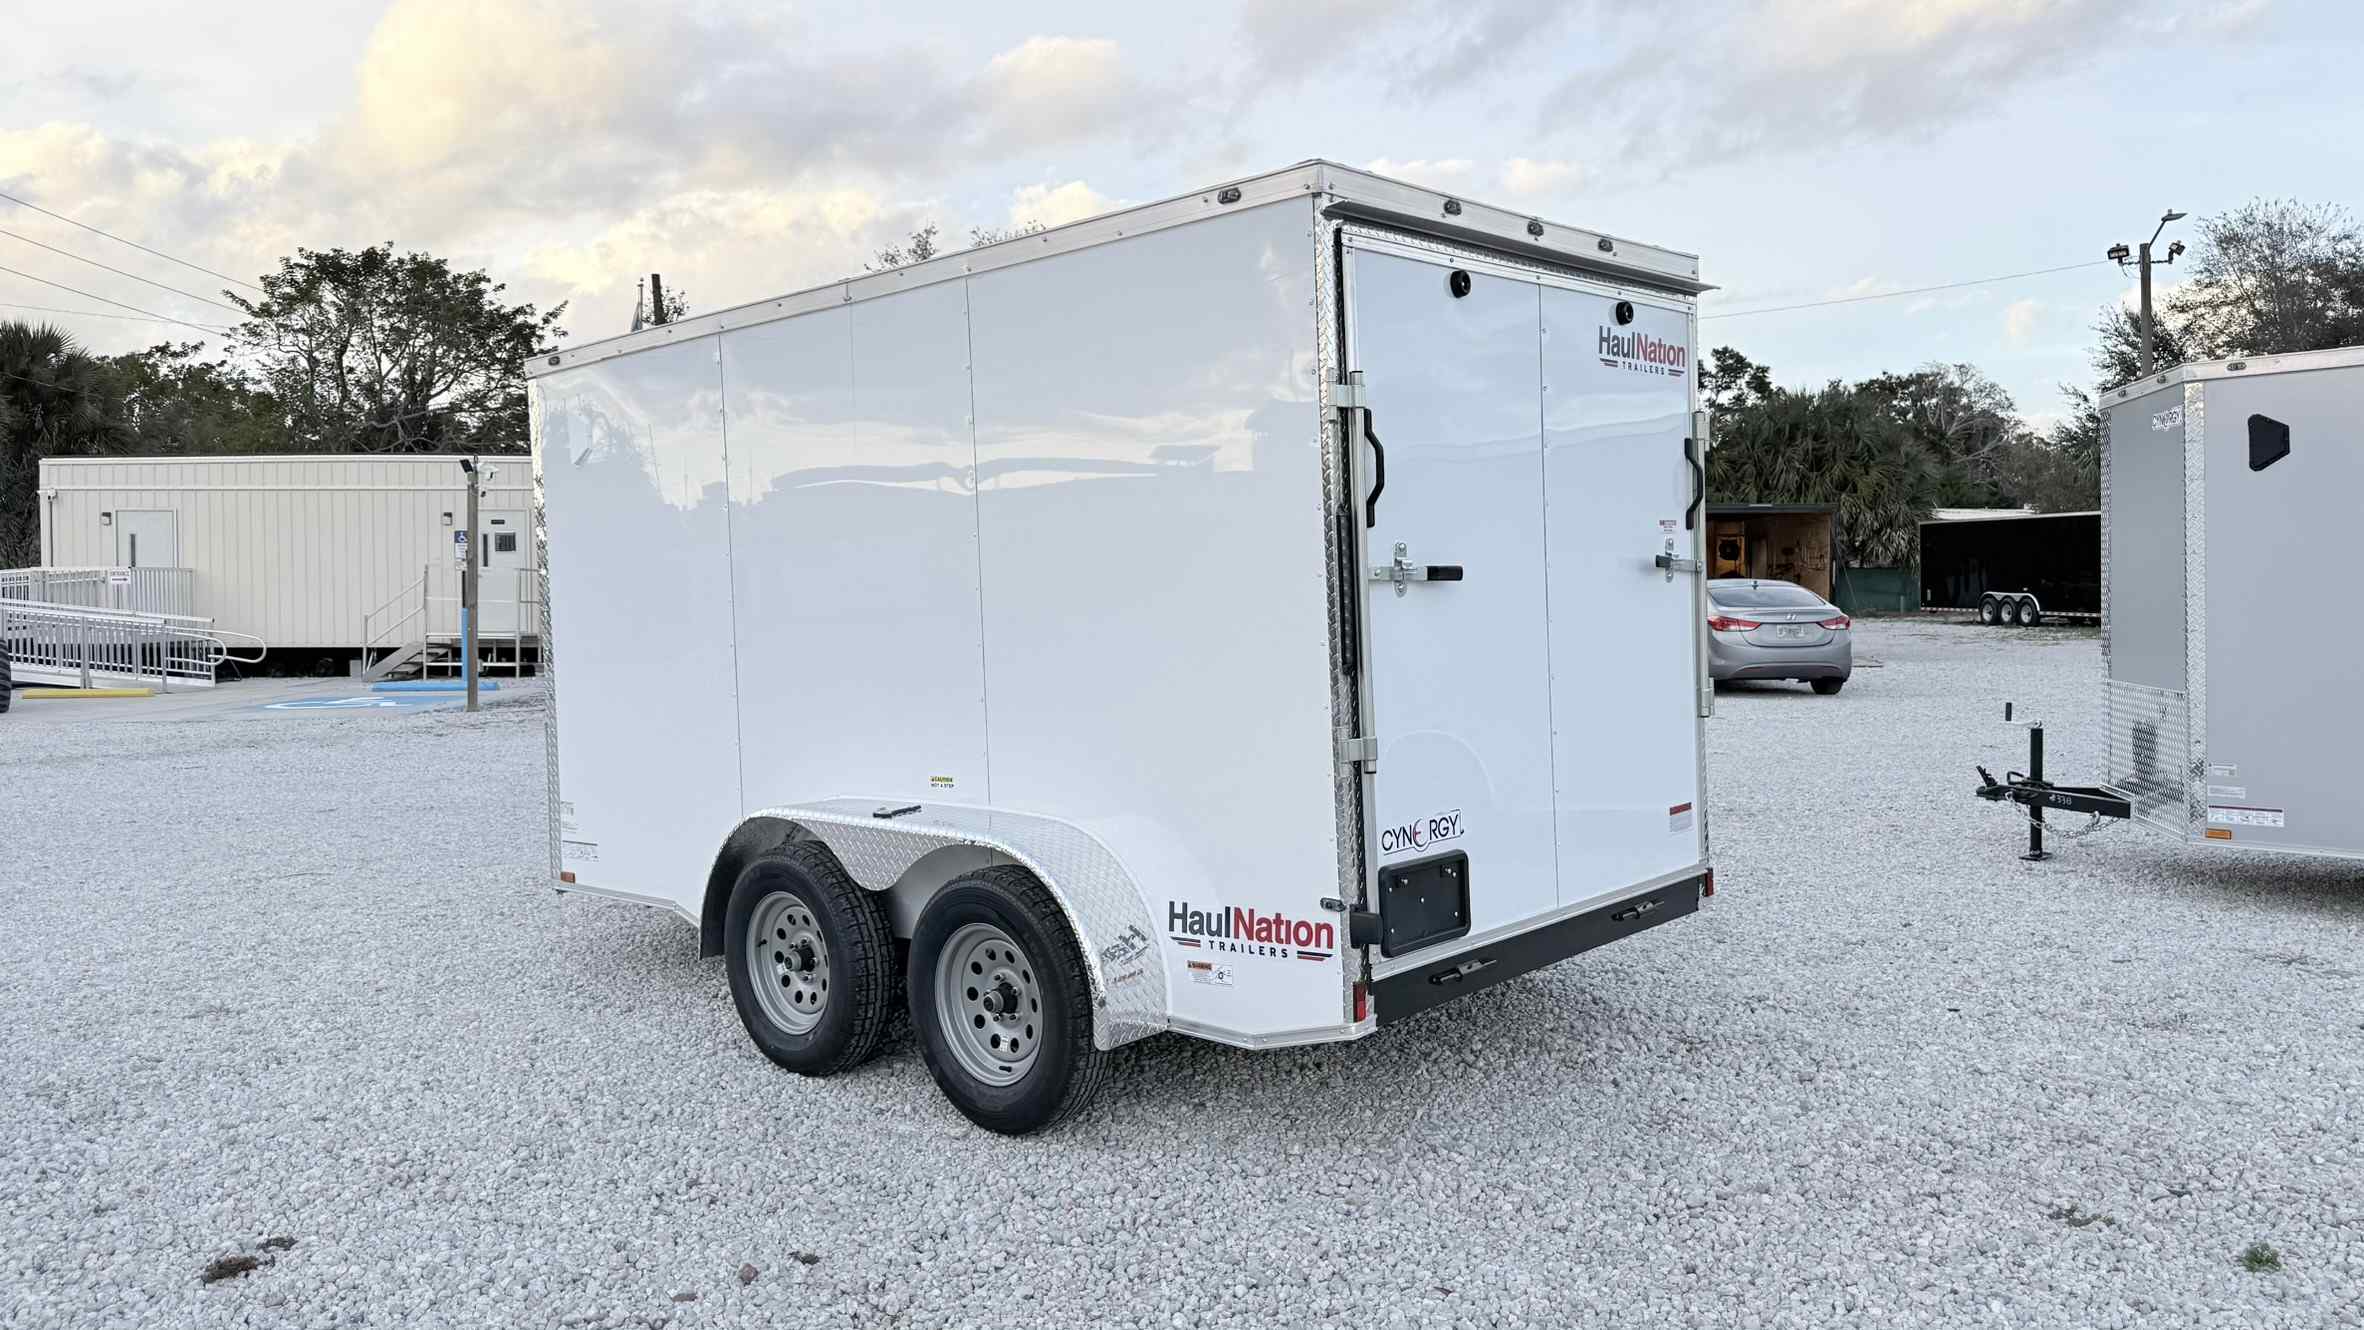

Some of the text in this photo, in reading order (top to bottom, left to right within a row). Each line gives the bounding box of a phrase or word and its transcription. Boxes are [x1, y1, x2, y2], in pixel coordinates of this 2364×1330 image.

[1599, 325, 1686, 368] HaulNation
[1622, 361, 1665, 375] TRAILERS
[1381, 813, 1460, 852] CYNERGY
[1168, 900, 1334, 949] HaulNation
[1208, 939, 1288, 958] TRAILERS
